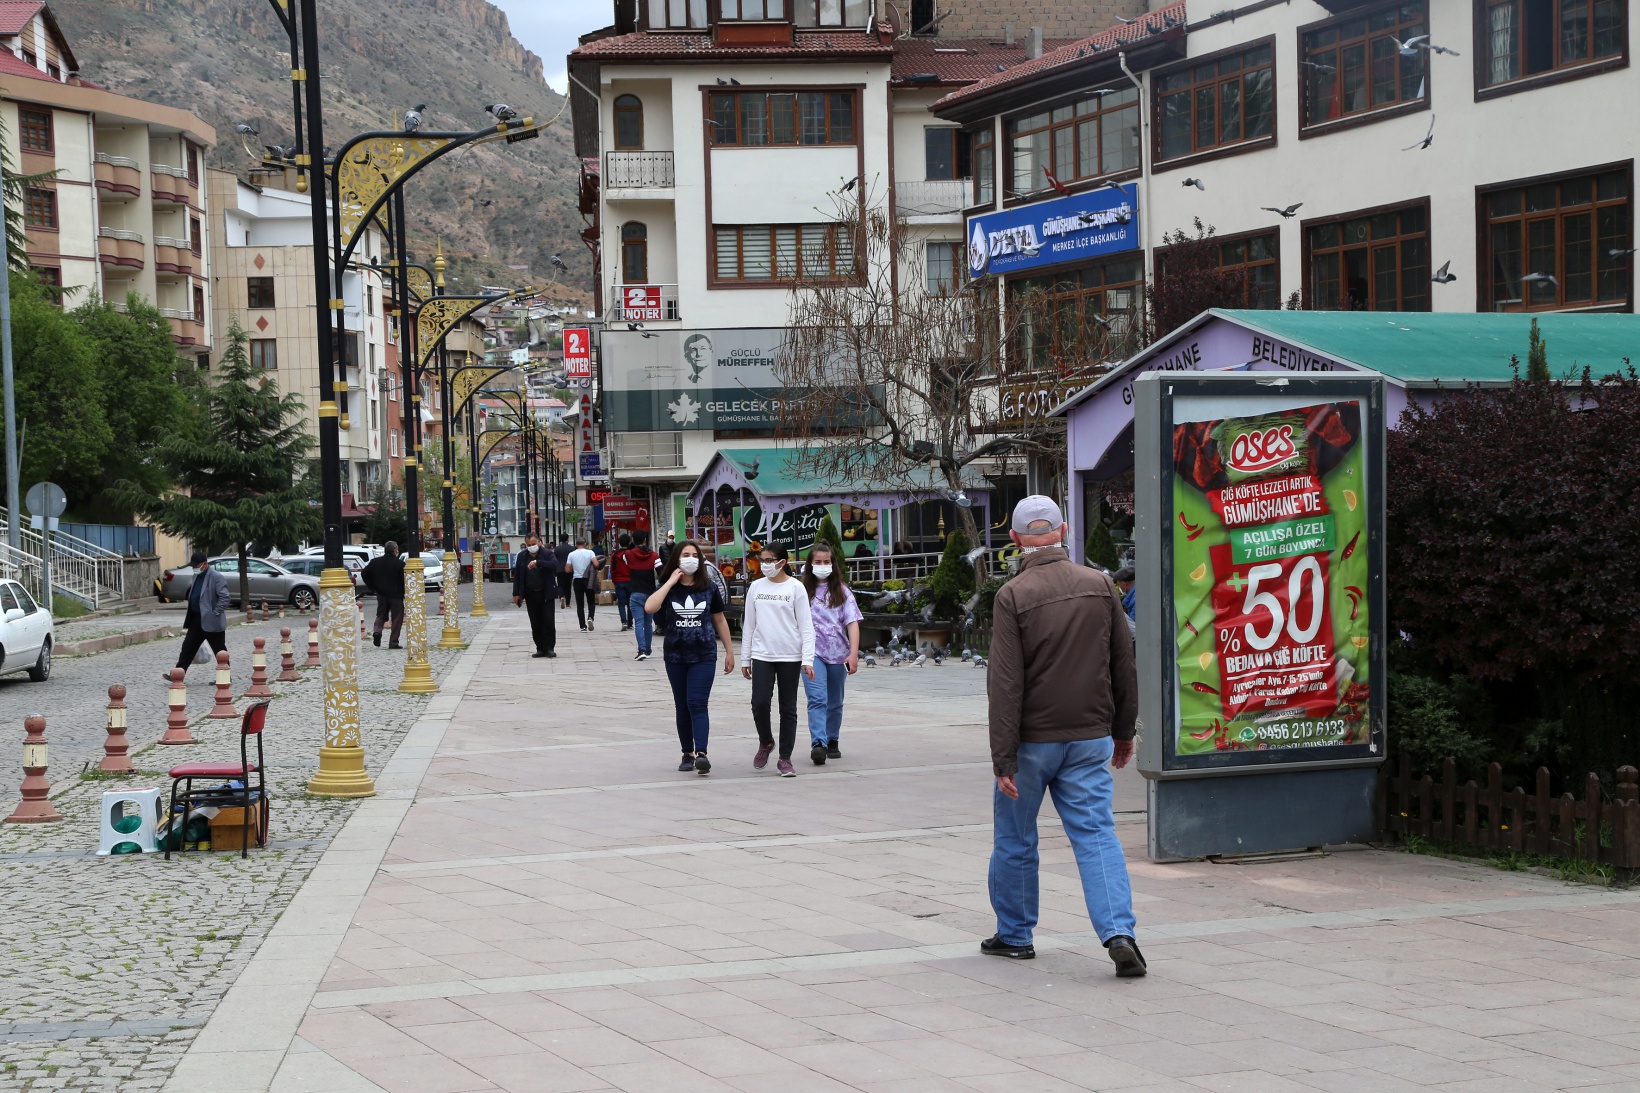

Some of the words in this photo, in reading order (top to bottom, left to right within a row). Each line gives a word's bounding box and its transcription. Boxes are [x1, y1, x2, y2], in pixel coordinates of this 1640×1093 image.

[1052, 239, 1075, 252] MERKEZ
[1076, 236, 1089, 249] İLÇE
[1090, 228, 1127, 246] BAŞKANLIĞI
[628, 288, 657, 307] 2.
[626, 308, 659, 320] NOTER
[568, 333, 585, 354] 2.
[717, 356, 774, 367] MÜREFFEH
[730, 349, 761, 359] GÜÇLÜ
[565, 357, 589, 373] NOTER
[1122, 342, 1202, 405] GHANE
[705, 400, 768, 413] GELECEK
[1018, 389, 1060, 417] FOTO
[717, 414, 761, 423] GÜMÜŞHANE
[1220, 486, 1235, 503] ÇİĞ
[1235, 484, 1260, 499] KÖFTE
[1260, 478, 1289, 496] LEZZETİ
[1290, 475, 1313, 491] ARTIK
[1223, 491, 1321, 525] GÜMÜŞHANE'DE
[1243, 527, 1293, 545] AÇILIŞA
[1295, 522, 1326, 537] ÖZEL
[1245, 549, 1252, 559] 7
[1255, 545, 1277, 558] GÜN
[1279, 538, 1325, 554] BOYUNCA
[675, 618, 702, 628] adidas
[1225, 652, 1273, 674] BEDAVA
[1292, 644, 1327, 664] KÖFTE
[1257, 723, 1289, 740] 0456
[1292, 721, 1313, 739] 213
